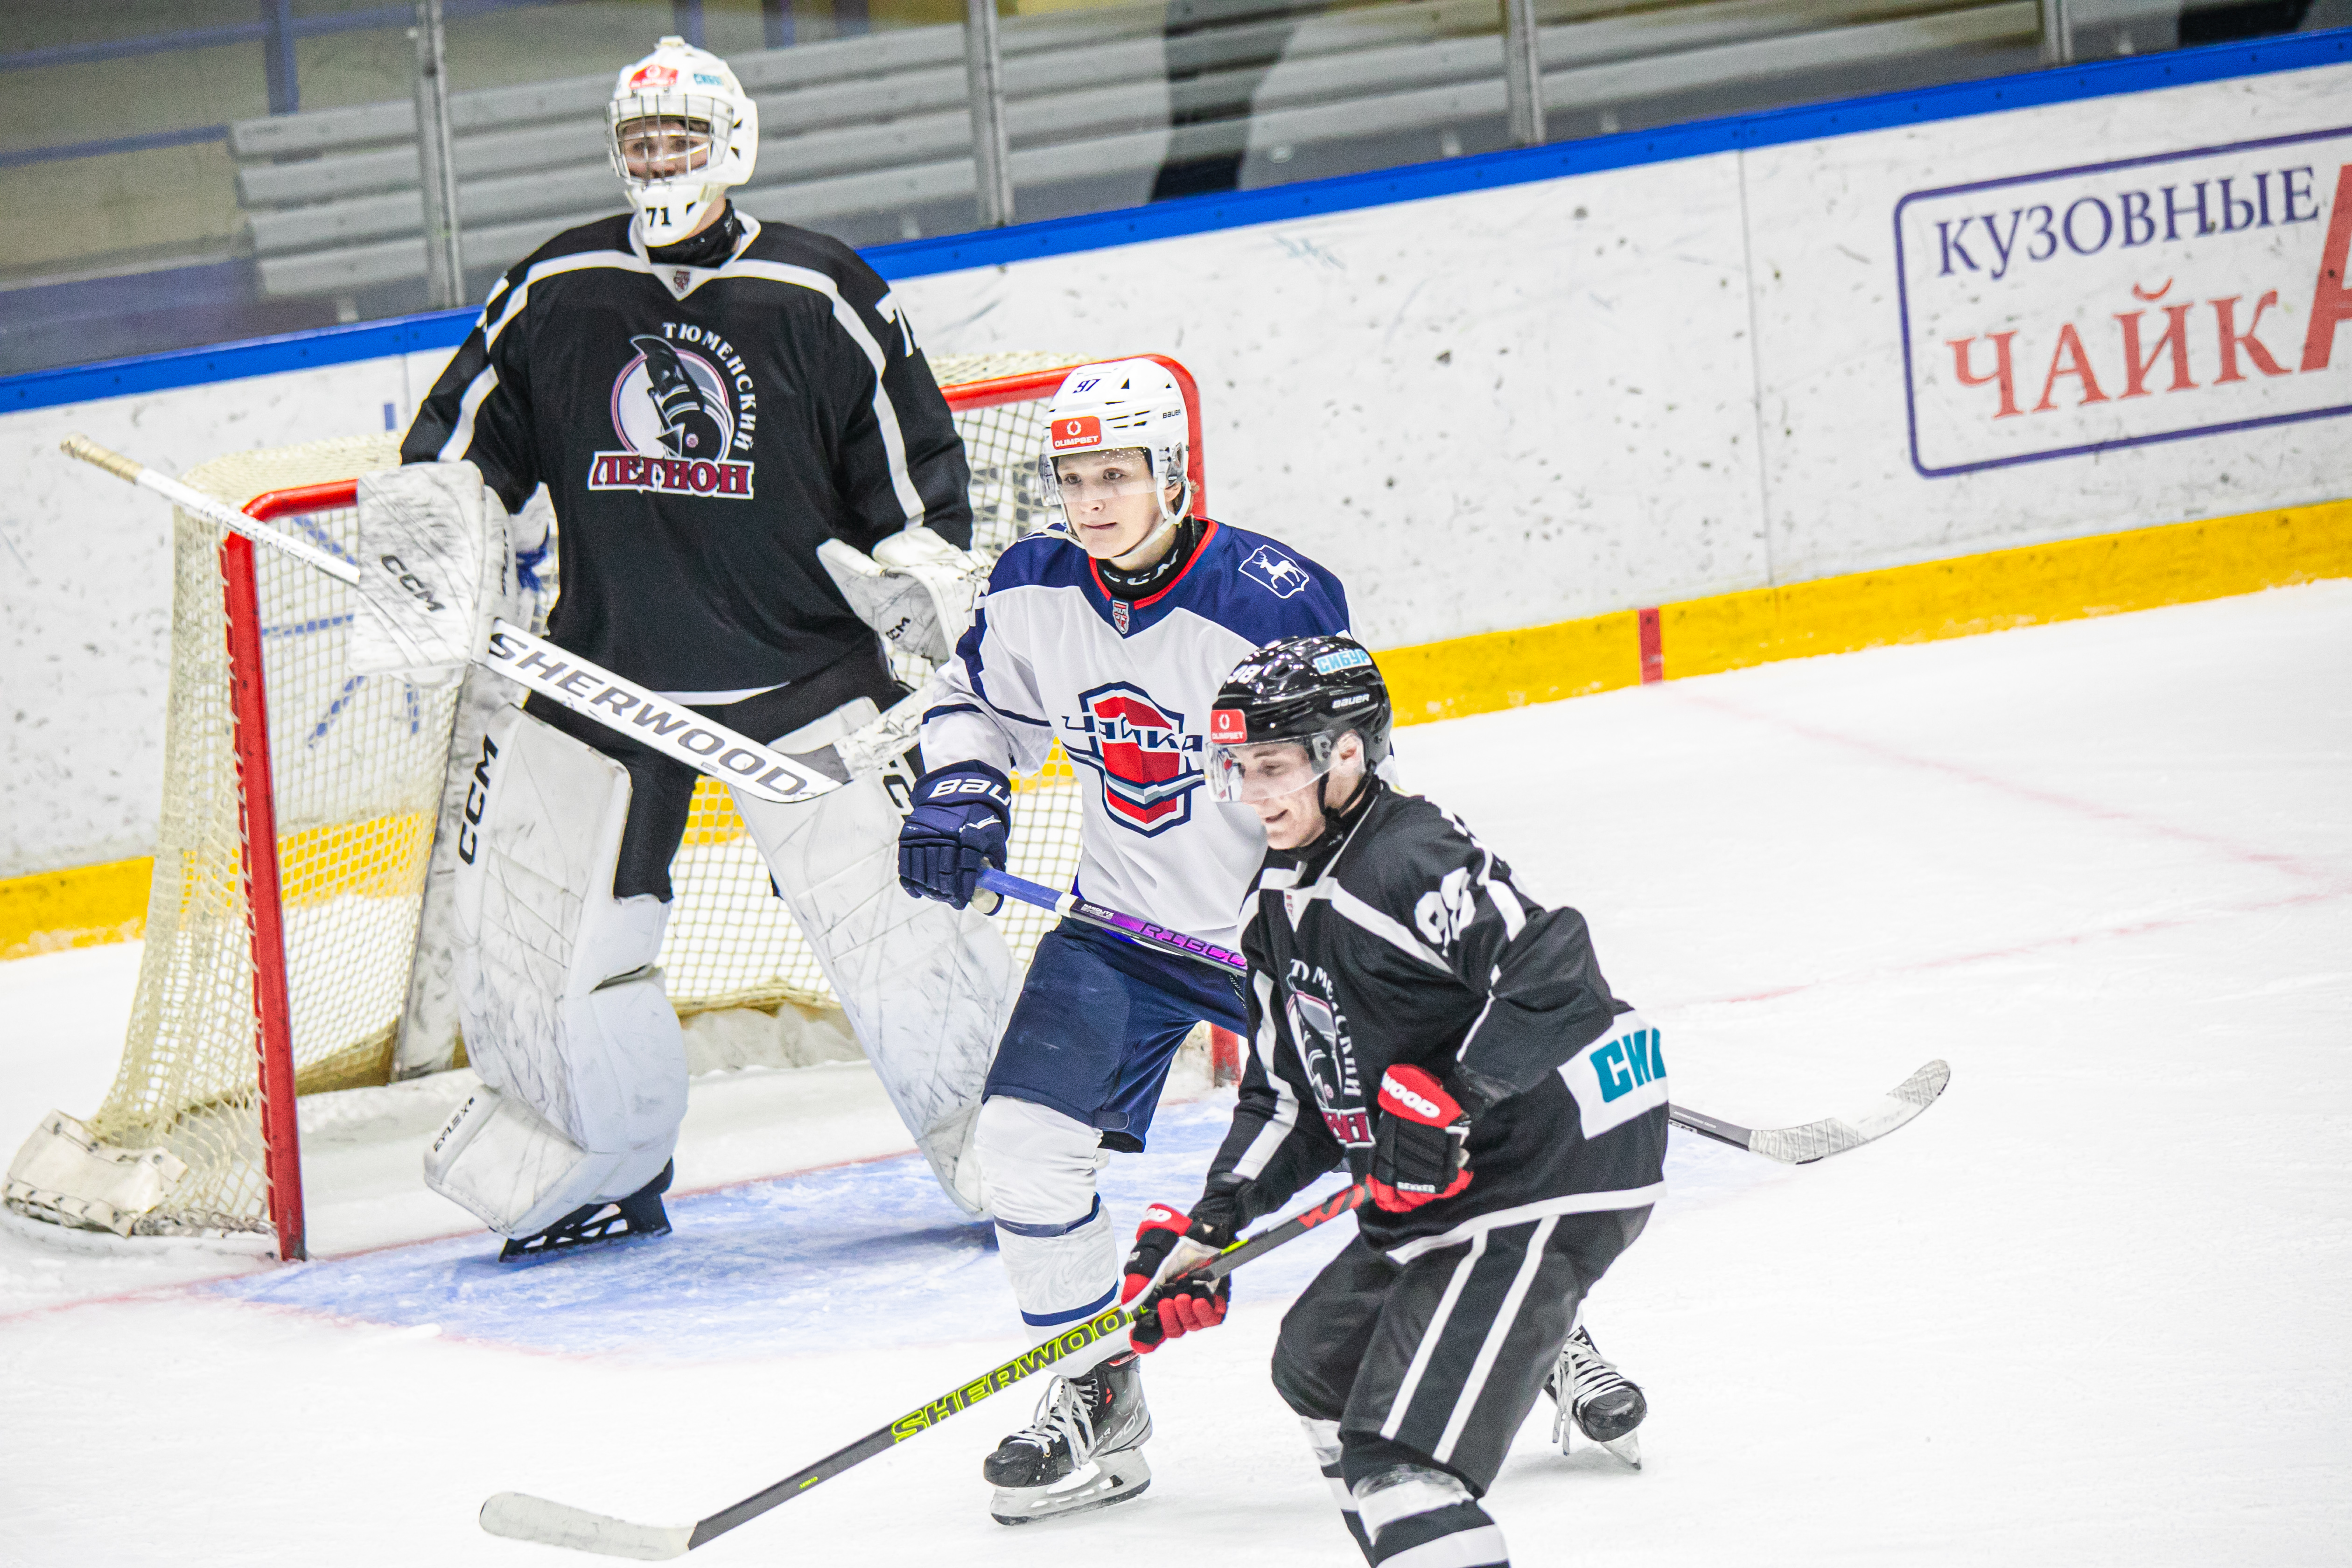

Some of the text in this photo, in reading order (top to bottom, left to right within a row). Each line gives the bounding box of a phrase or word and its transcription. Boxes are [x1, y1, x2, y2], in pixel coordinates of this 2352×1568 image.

[646, 207, 671, 227] 71
[1935, 165, 2319, 280] КУЗОВНЫЕ
[875, 292, 921, 357] 7
[662, 322, 756, 451] ТЮМЕНСКИЙ
[1072, 378, 1102, 394] 97
[1054, 435, 1099, 448] OLIMPBET
[588, 452, 754, 498] ЛЕГИОН
[381, 554, 446, 612] CCM
[1226, 665, 1262, 684] 98
[1316, 650, 1370, 672] СИБУР
[489, 633, 807, 796] SHERWOOD
[1331, 693, 1370, 709] BAUER
[459, 734, 499, 866] CCM
[891, 1305, 1148, 1443] SHERWOO
